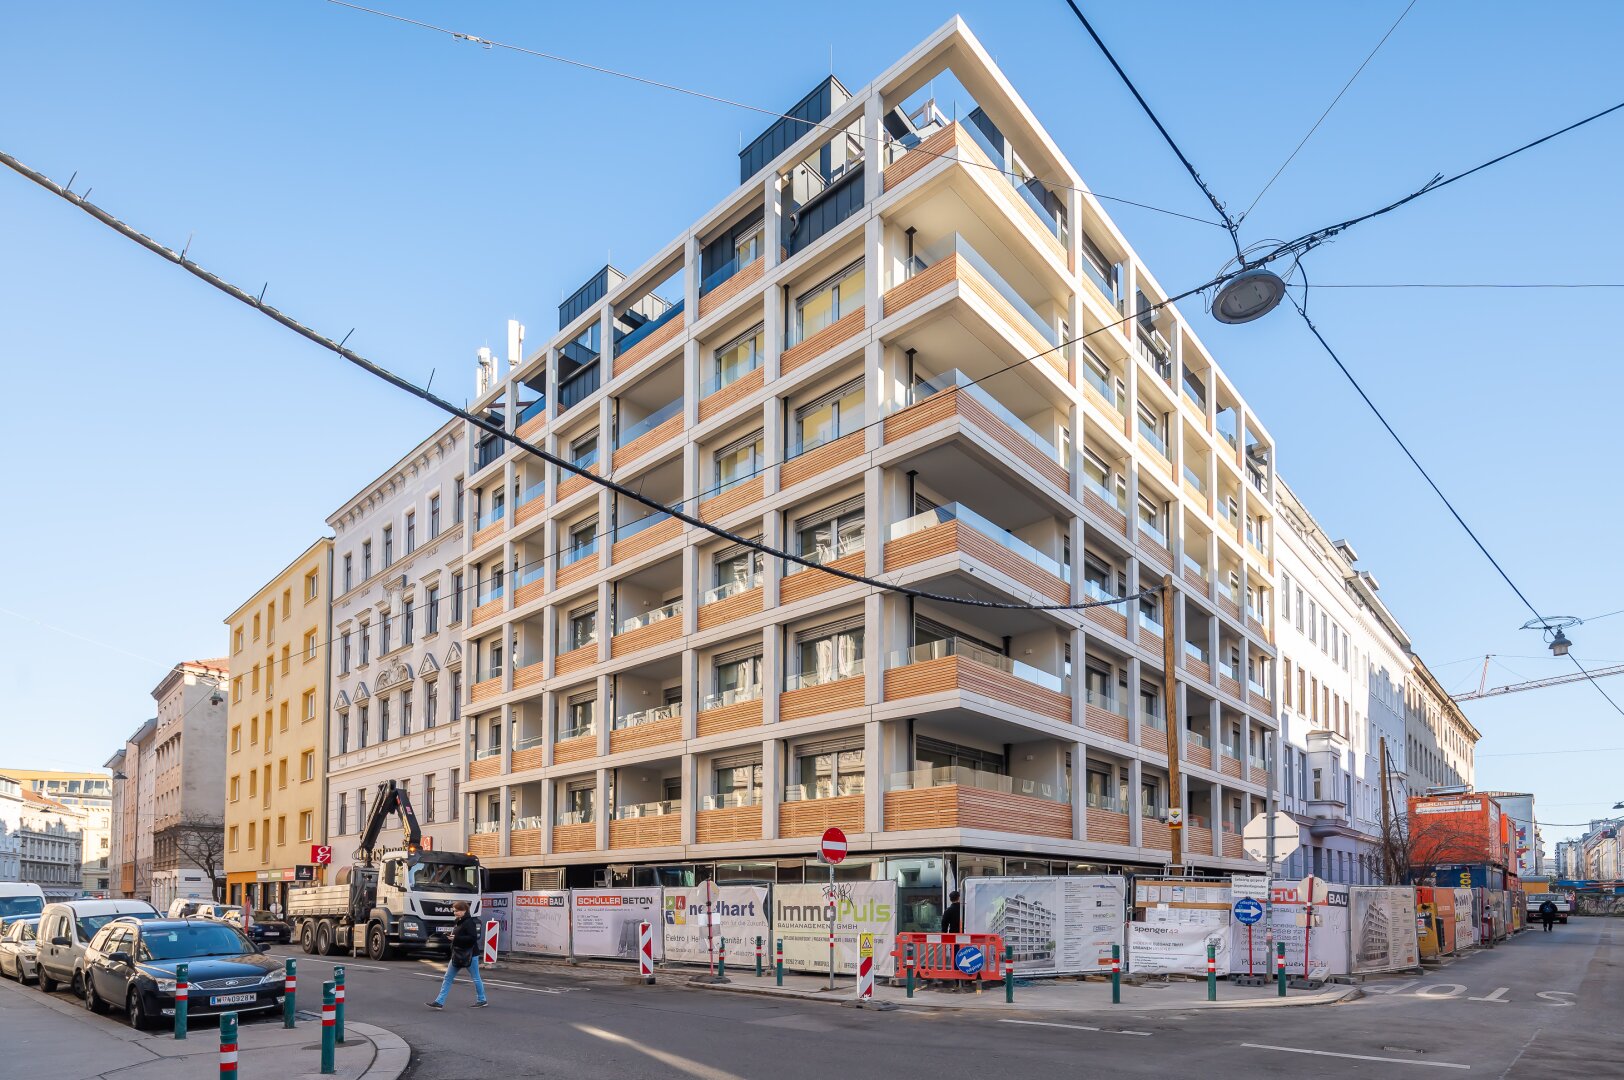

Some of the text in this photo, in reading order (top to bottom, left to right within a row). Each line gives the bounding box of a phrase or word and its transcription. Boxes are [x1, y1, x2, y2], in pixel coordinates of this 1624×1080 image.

[516, 896, 564, 906] SCHÜLLER BAU
[577, 896, 653, 905] SCHÜLLER BETON
[1328, 893, 1347, 906] BAU
[689, 901, 755, 917] nedhart
[1360, 979, 1577, 1007] STOP
